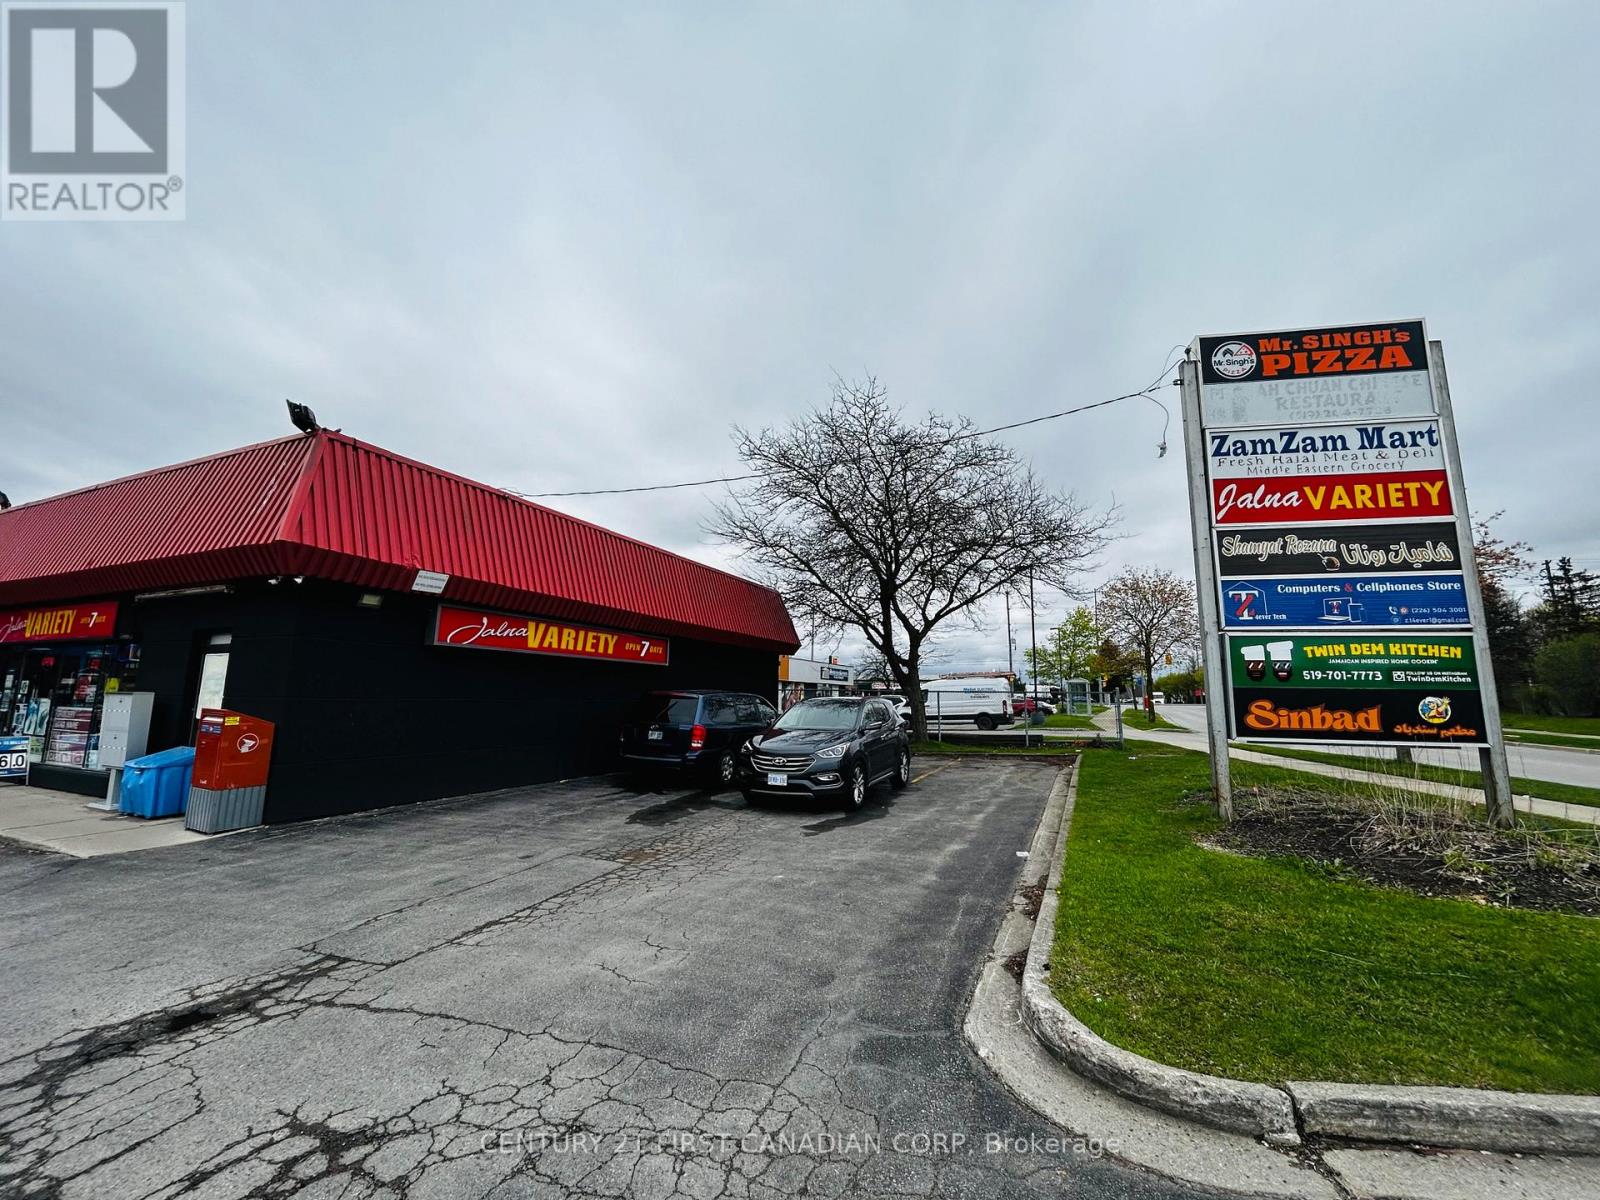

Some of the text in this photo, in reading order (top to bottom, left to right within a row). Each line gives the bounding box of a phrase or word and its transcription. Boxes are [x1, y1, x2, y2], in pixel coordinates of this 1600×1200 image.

[1258, 328, 1411, 353] Mr. SINGH's
[1261, 346, 1413, 377] PIZZA
[1211, 423, 1439, 457] ZamZam Mart
[1218, 447, 1435, 468] Fresh Halal Meat & Deli
[1247, 460, 1405, 477] Middle Eastern Grocery
[1216, 480, 1445, 521] Jalna VARIETY
[1221, 534, 1337, 562] Shamyat Rozana
[1277, 580, 1461, 594] Computers & Cellphones Store
[25, 609, 77, 638] VARIETY
[447, 616, 618, 655] Jalna VARIETY
[640, 640, 650, 657] 7
[1303, 643, 1462, 659] TWIN DEM KITCHEN
[1302, 670, 1383, 681] 519-701-7773
[1246, 700, 1383, 732] Sinbad
